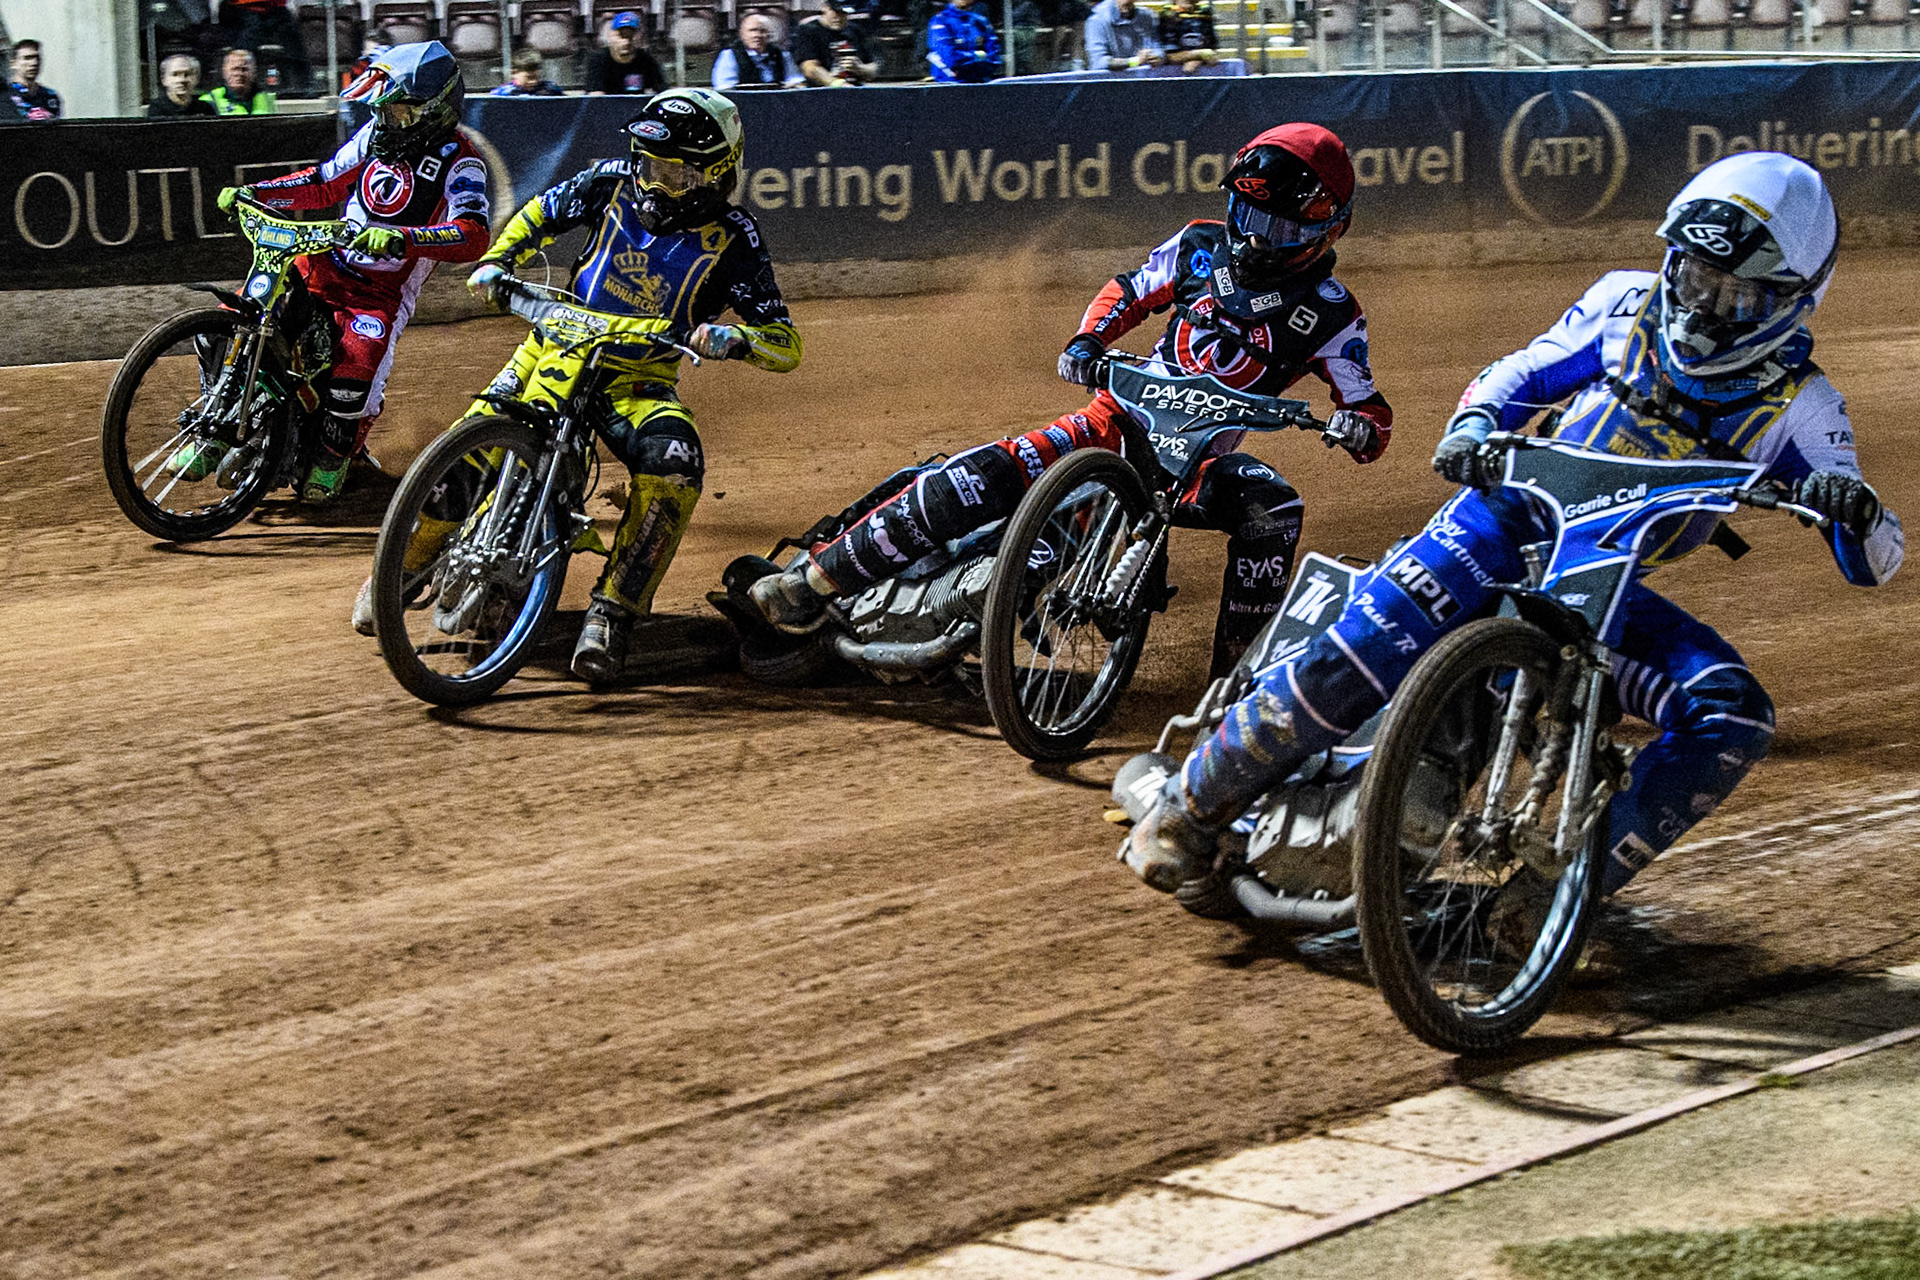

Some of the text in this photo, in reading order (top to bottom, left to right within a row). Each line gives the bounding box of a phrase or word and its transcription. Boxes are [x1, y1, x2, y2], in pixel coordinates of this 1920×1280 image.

[1521, 136, 1604, 177] ATPI
[1687, 117, 1919, 175] Deliverin
[420, 158, 440, 178] 6
[932, 141, 1110, 202] World
[1132, 140, 1226, 196] Cla
[1354, 131, 1464, 186] avel
[603, 277, 660, 316] MONARCHS
[1291, 306, 1319, 332] 5
[1614, 483, 1647, 503] Cull
[1236, 555, 1284, 579] EYAS
[1389, 556, 1454, 623] MPL
[1353, 592, 1399, 634] Paul
